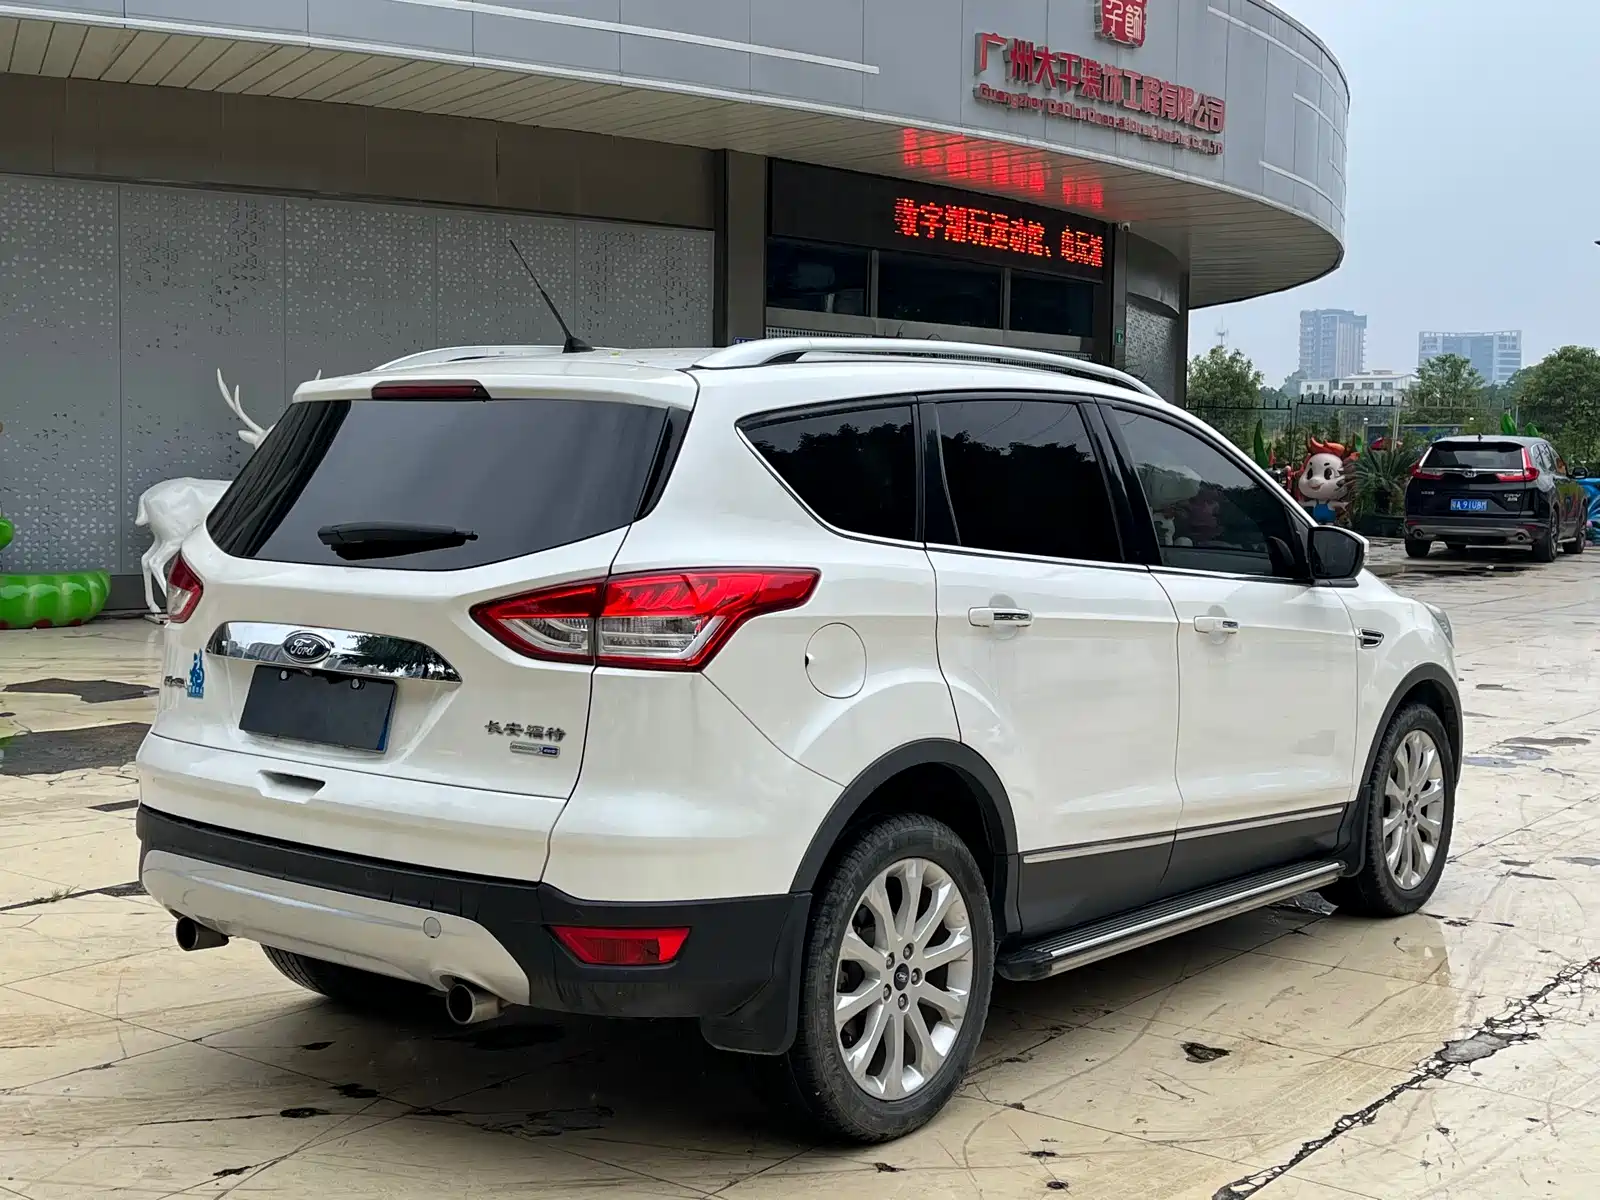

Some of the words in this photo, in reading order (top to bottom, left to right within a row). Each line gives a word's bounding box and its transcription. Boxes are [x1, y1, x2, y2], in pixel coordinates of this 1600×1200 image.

[976, 33, 1225, 133] 广州大千装饰工程有限公司
[289, 638, 318, 656] Ford
[484, 719, 567, 743] 长安福特
